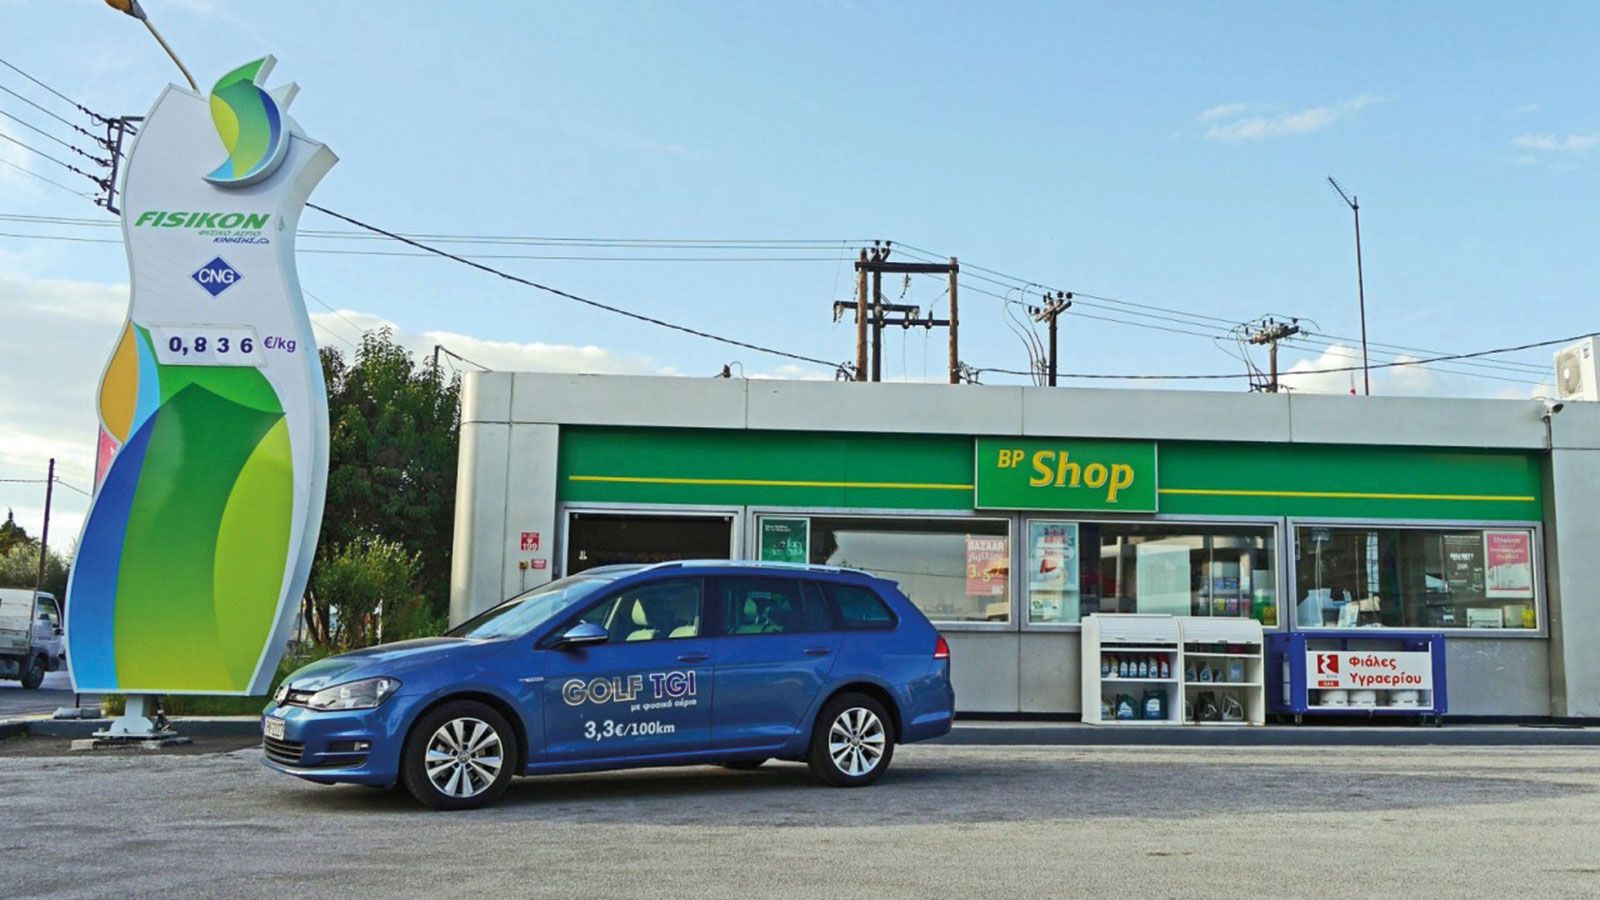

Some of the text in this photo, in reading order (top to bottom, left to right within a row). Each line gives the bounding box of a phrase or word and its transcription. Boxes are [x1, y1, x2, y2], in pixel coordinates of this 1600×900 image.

[135, 211, 270, 229] FISIKON
[198, 268, 234, 284] CNG
[264, 336, 296, 353] €/kg
[997, 449, 1134, 502] BP Shop
[968, 540, 1004, 551] BAZAAR
[1349, 655, 1397, 670] Φιάλες
[1350, 672, 1422, 686] Υγραερίου
[562, 670, 697, 706] GOLF TGI
[584, 720, 675, 741] 3,3€/100km
